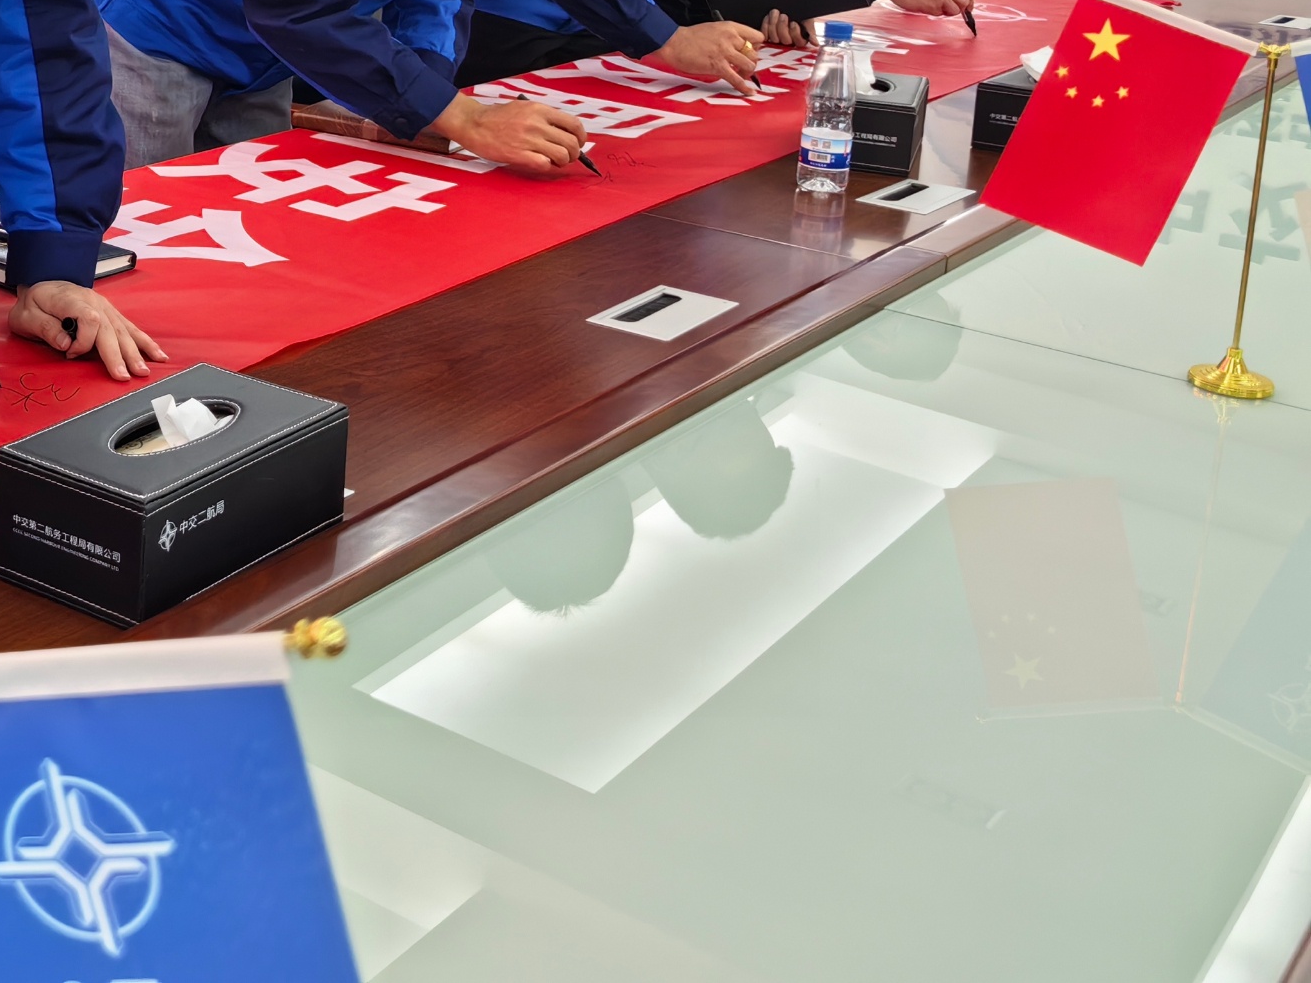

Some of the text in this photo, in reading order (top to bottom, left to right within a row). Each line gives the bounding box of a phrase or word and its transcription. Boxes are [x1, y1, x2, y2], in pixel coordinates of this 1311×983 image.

[853, 132, 898, 143] 工程局有限公司
[179, 500, 225, 534] 中交二航局
[12, 514, 121, 563] 中交第二航务工程局有限公司
